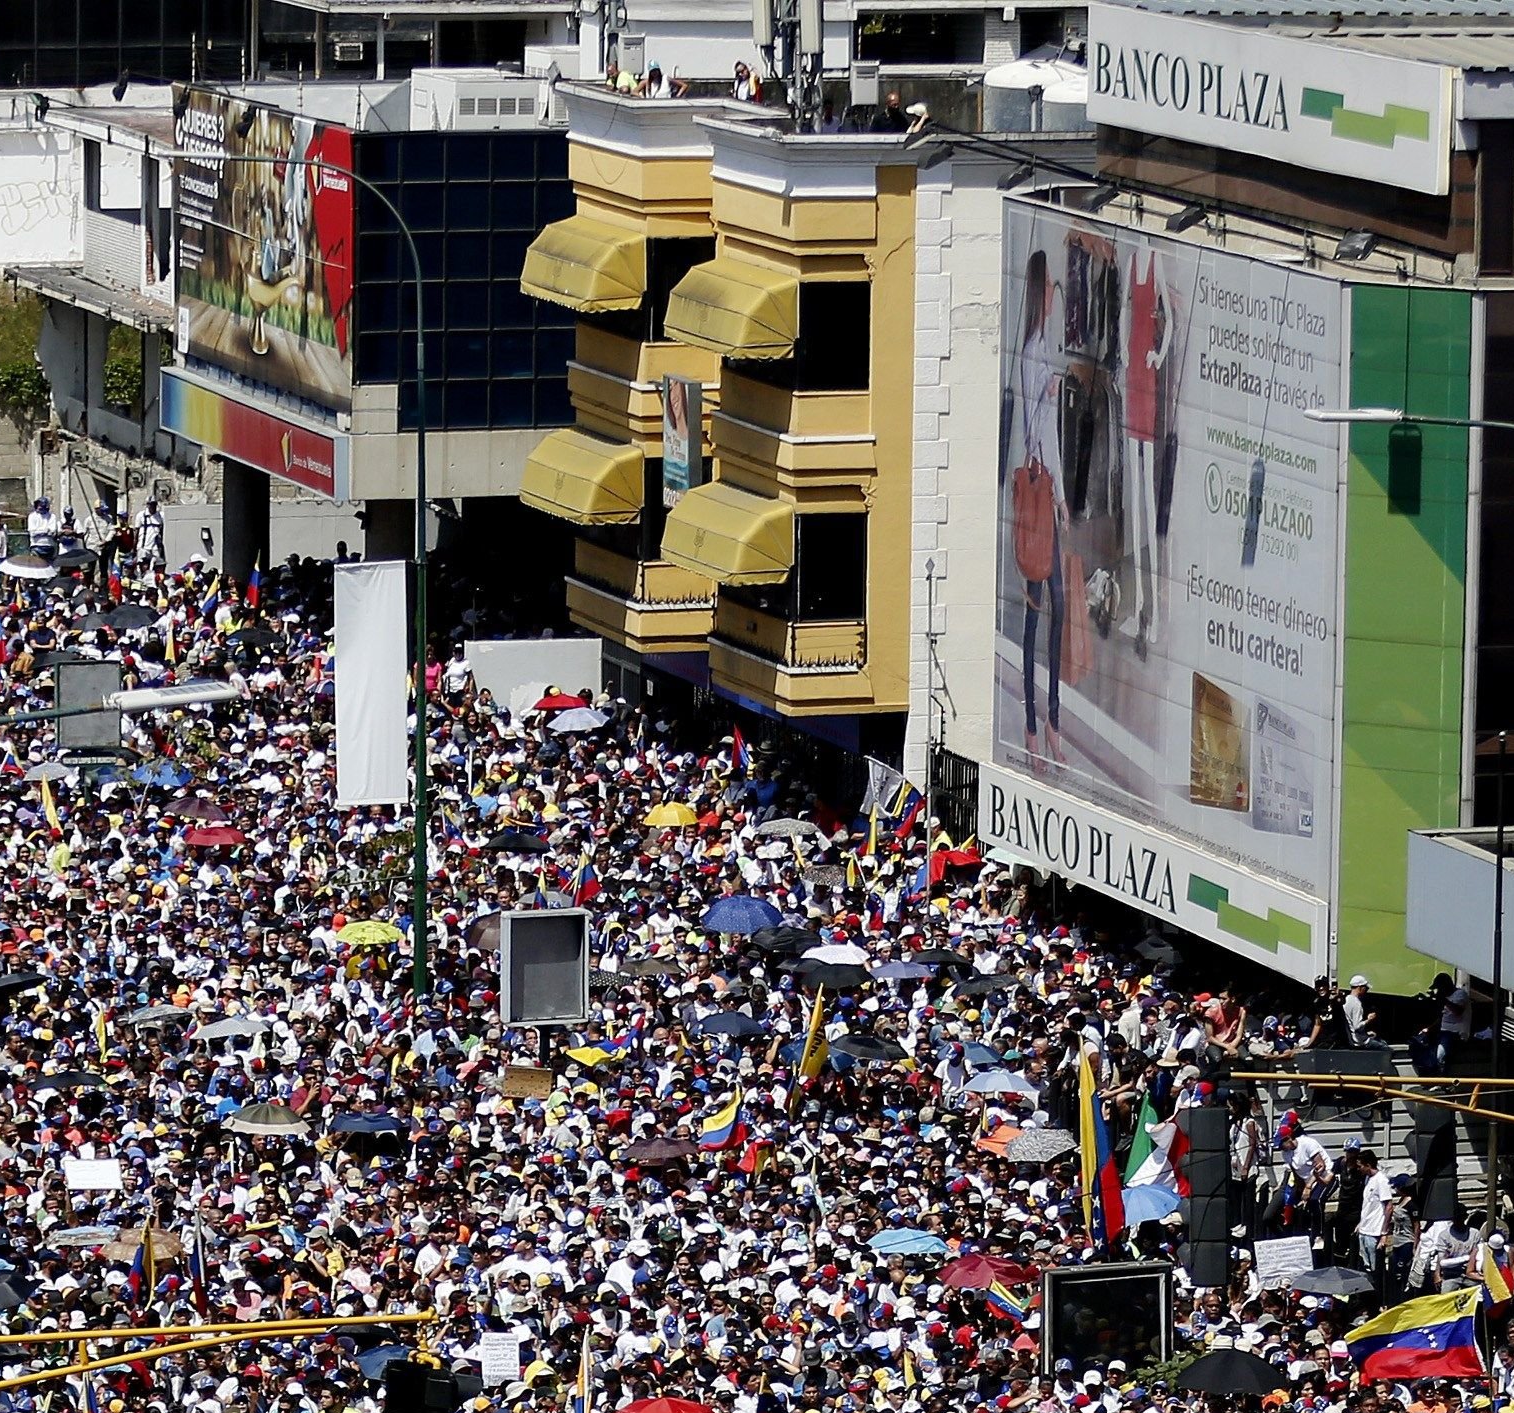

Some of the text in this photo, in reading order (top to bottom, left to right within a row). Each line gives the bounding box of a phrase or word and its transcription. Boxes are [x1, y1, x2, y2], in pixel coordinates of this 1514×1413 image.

[1094, 42, 1289, 132] BANCO PLAZA
[1199, 276, 1325, 337] Si tienes una TDC Plaza
[1209, 324, 1314, 373] puedes solicitar un
[1199, 353, 1261, 397] ExtraPlaza
[1274, 376, 1307, 411] través
[1206, 426, 1317, 474] www.bancoplaza.com
[1187, 564, 1327, 641] ¡Es como tener dinero
[1207, 619, 1303, 677] en tu cartera!
[990, 783, 1080, 871] BANCO
[1086, 824, 1178, 915] PLAZA
